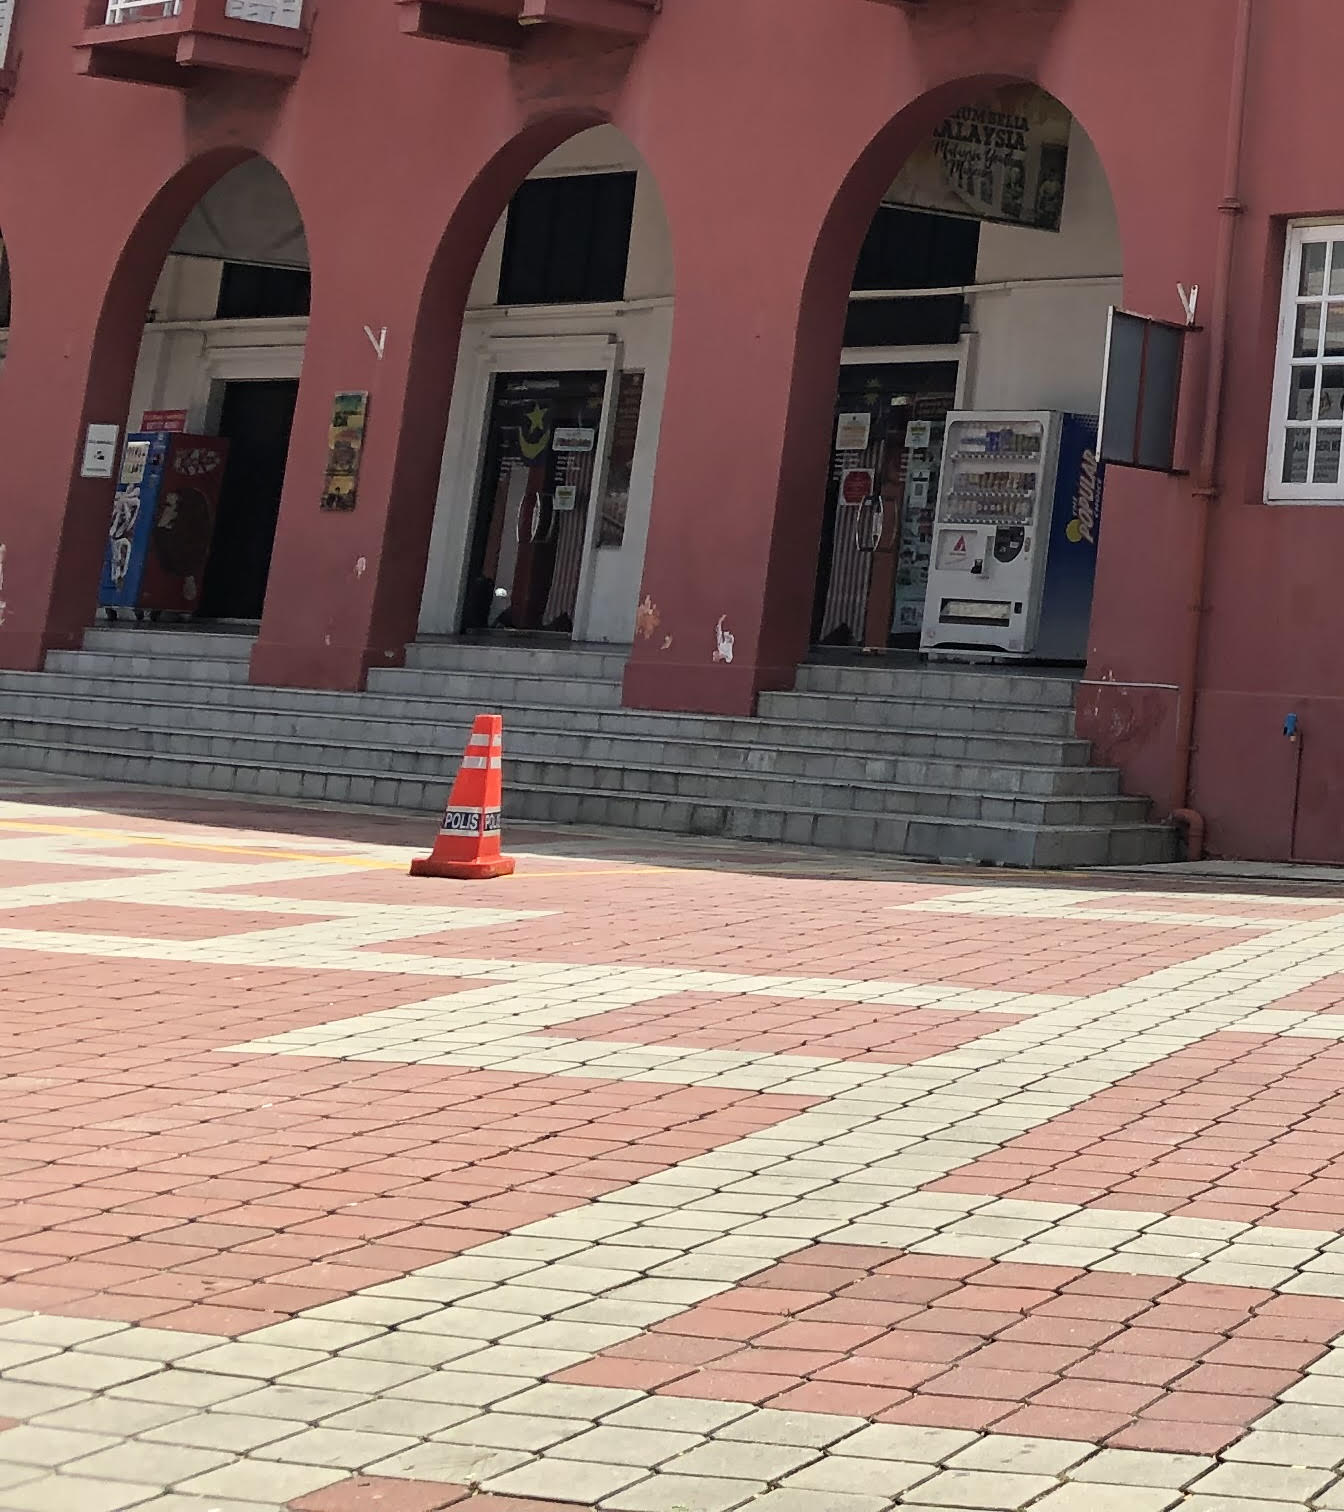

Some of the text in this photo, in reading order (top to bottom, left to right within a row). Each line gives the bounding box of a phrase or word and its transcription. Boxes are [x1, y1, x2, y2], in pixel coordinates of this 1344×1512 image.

[933, 118, 1027, 152] ALAYSIA
[1079, 449, 1098, 543] POPULAR
[444, 812, 479, 830] POLIS
